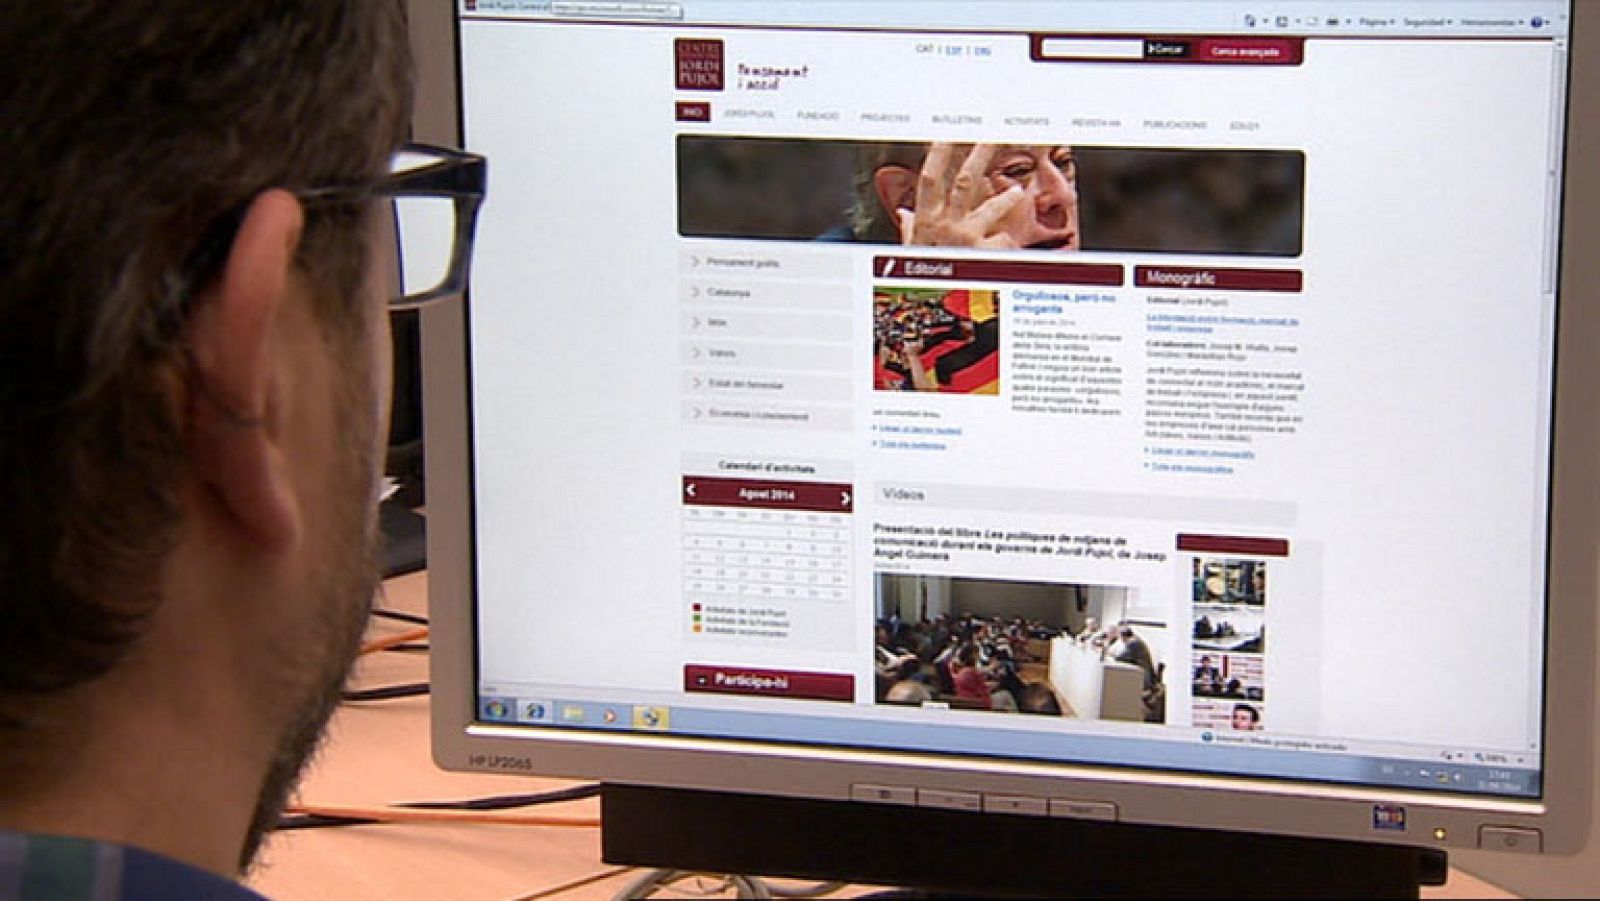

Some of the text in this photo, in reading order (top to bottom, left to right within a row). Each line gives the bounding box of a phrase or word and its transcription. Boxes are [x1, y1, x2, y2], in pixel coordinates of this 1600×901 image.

[916, 43, 934, 54] CAT
[1211, 46, 1238, 58] Cerca
[679, 59, 720, 71] JORDI
[738, 63, 809, 78] Pensament
[679, 72, 720, 88] PUJOL
[903, 260, 954, 277] Editorial
[1146, 269, 1217, 287] Monogràfic
[1102, 294, 1116, 303] no
[719, 460, 764, 471] Calendari
[739, 487, 795, 502] Agost 2014
[873, 522, 936, 536] Presentació
[937, 527, 953, 536] del
[984, 529, 1004, 539] Les
[1058, 533, 1071, 543] de
[1114, 537, 1127, 546] de
[873, 537, 1168, 562] comunicació durant els governs de Jordi Pujol, de Josep
[714, 671, 790, 690] Participa-hi
[469, 754, 532, 770] HP LP2065
